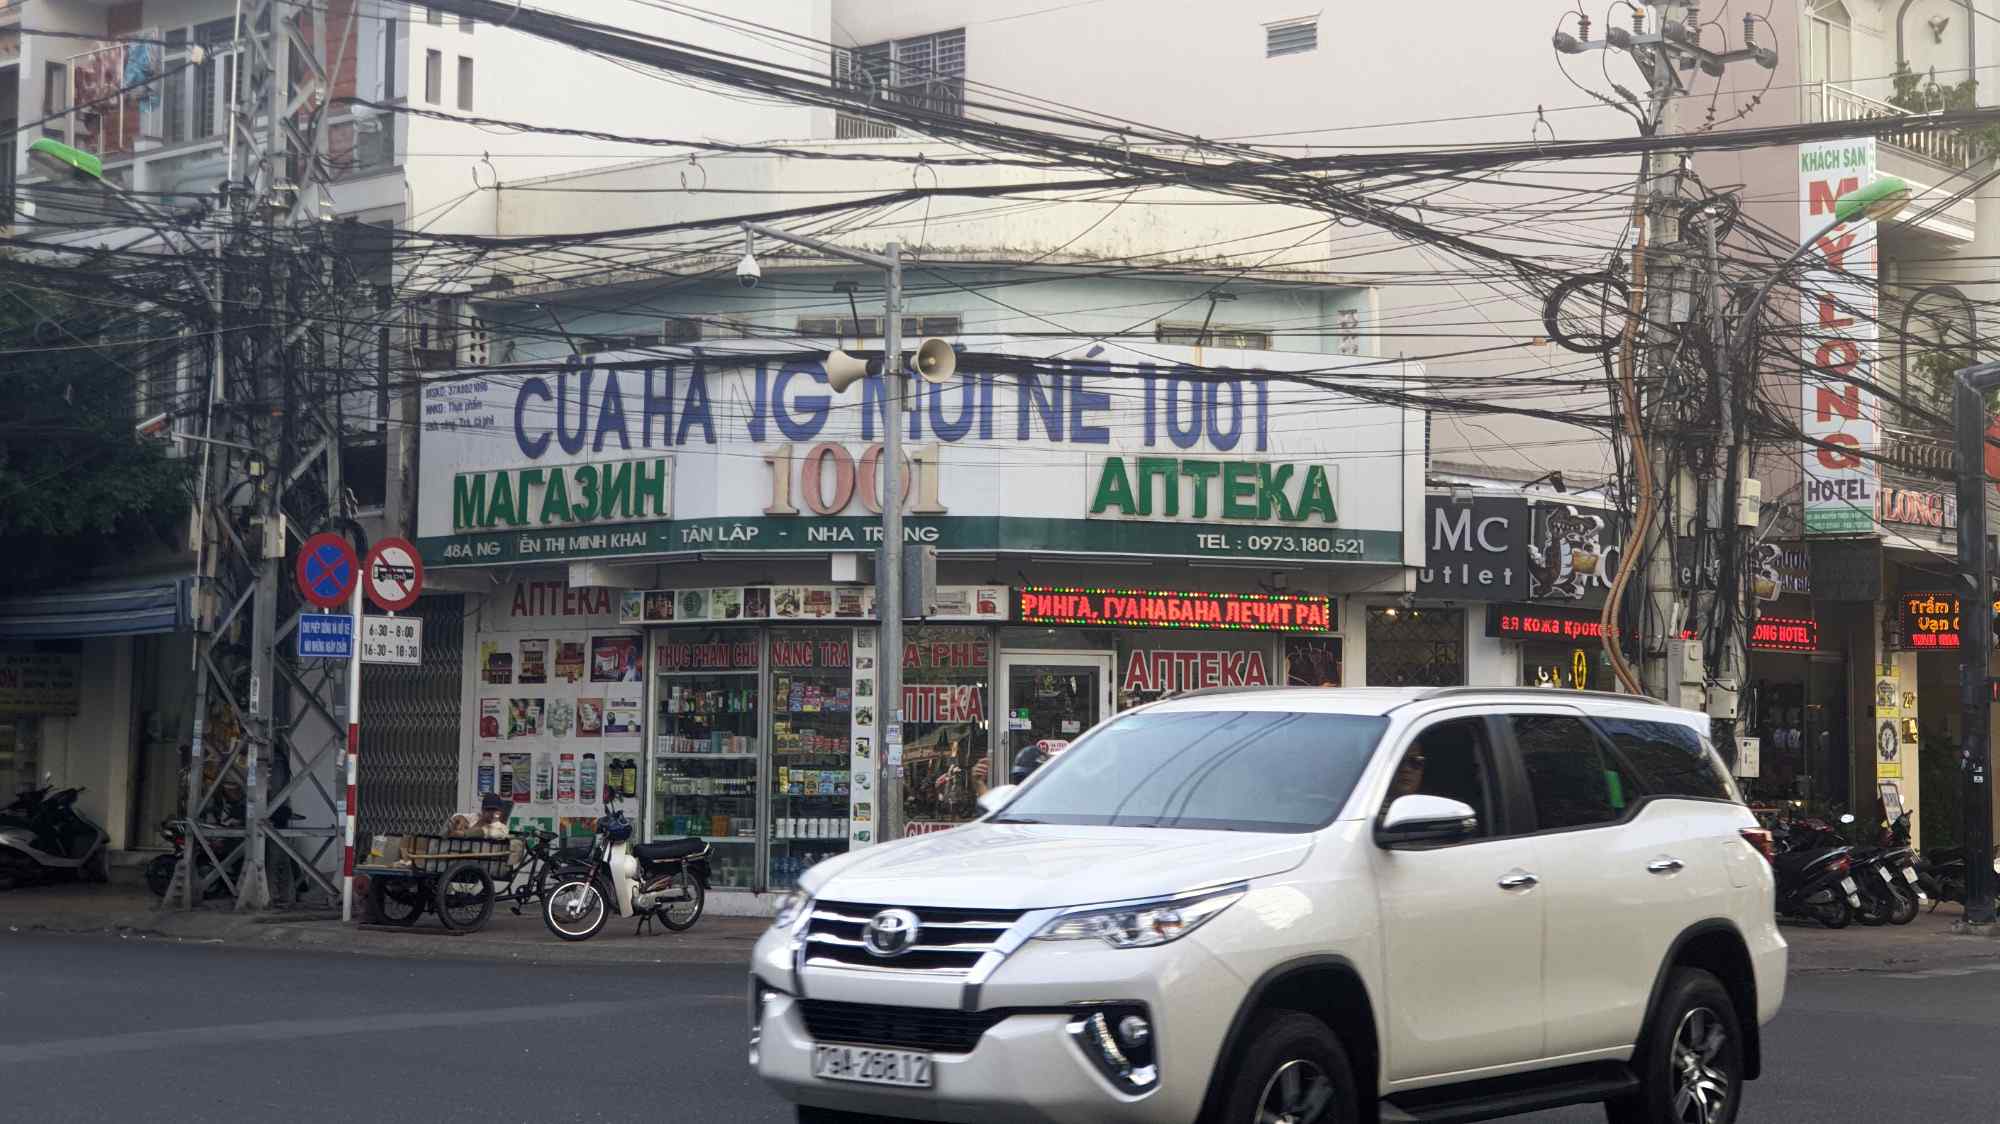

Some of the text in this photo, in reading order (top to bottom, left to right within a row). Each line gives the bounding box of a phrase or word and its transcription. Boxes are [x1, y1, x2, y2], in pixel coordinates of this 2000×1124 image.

[1801, 146, 1866, 172] KHÁCH SẠN
[1815, 291, 1861, 470] LONG
[514, 354, 632, 459] CỬA
[1017, 346, 1110, 444] NÉ
[1138, 361, 1269, 452] 1001
[453, 459, 668, 529] МАГАЗИН
[763, 441, 948, 515] 1001
[1089, 456, 1338, 522] АПТЕКА
[1807, 478, 1871, 501] HOTEL
[1883, 488, 1944, 527] LONG
[443, 543, 473, 559] 48A
[545, 537, 566, 555] THỊ
[569, 534, 606, 551] MINH
[610, 531, 647, 548] KHAI
[680, 525, 713, 543] TÂN
[807, 526, 855, 542] NHA
[862, 526, 940, 542] TRNG
[1197, 534, 1230, 549] TEL
[1247, 535, 1365, 554] 0973.180.521
[1432, 507, 1509, 552] MC
[1419, 563, 1513, 586] utlet
[511, 581, 613, 617] АПТЕКА
[1023, 594, 1098, 618] РИНГА,
[1103, 597, 1219, 622] ГУАНАБАНА
[1226, 602, 1292, 625] ЛЕЧИТ
[369, 625, 388, 637] 6:30
[396, 626, 414, 638] 8:00
[1523, 617, 1560, 634] кожа
[1778, 626, 1809, 643] HOTEL
[364, 643, 386, 656] 16:30
[396, 645, 418, 658] 18:30
[1123, 649, 1268, 693] АПТЕКА
[901, 685, 985, 723] ПТЕКА
